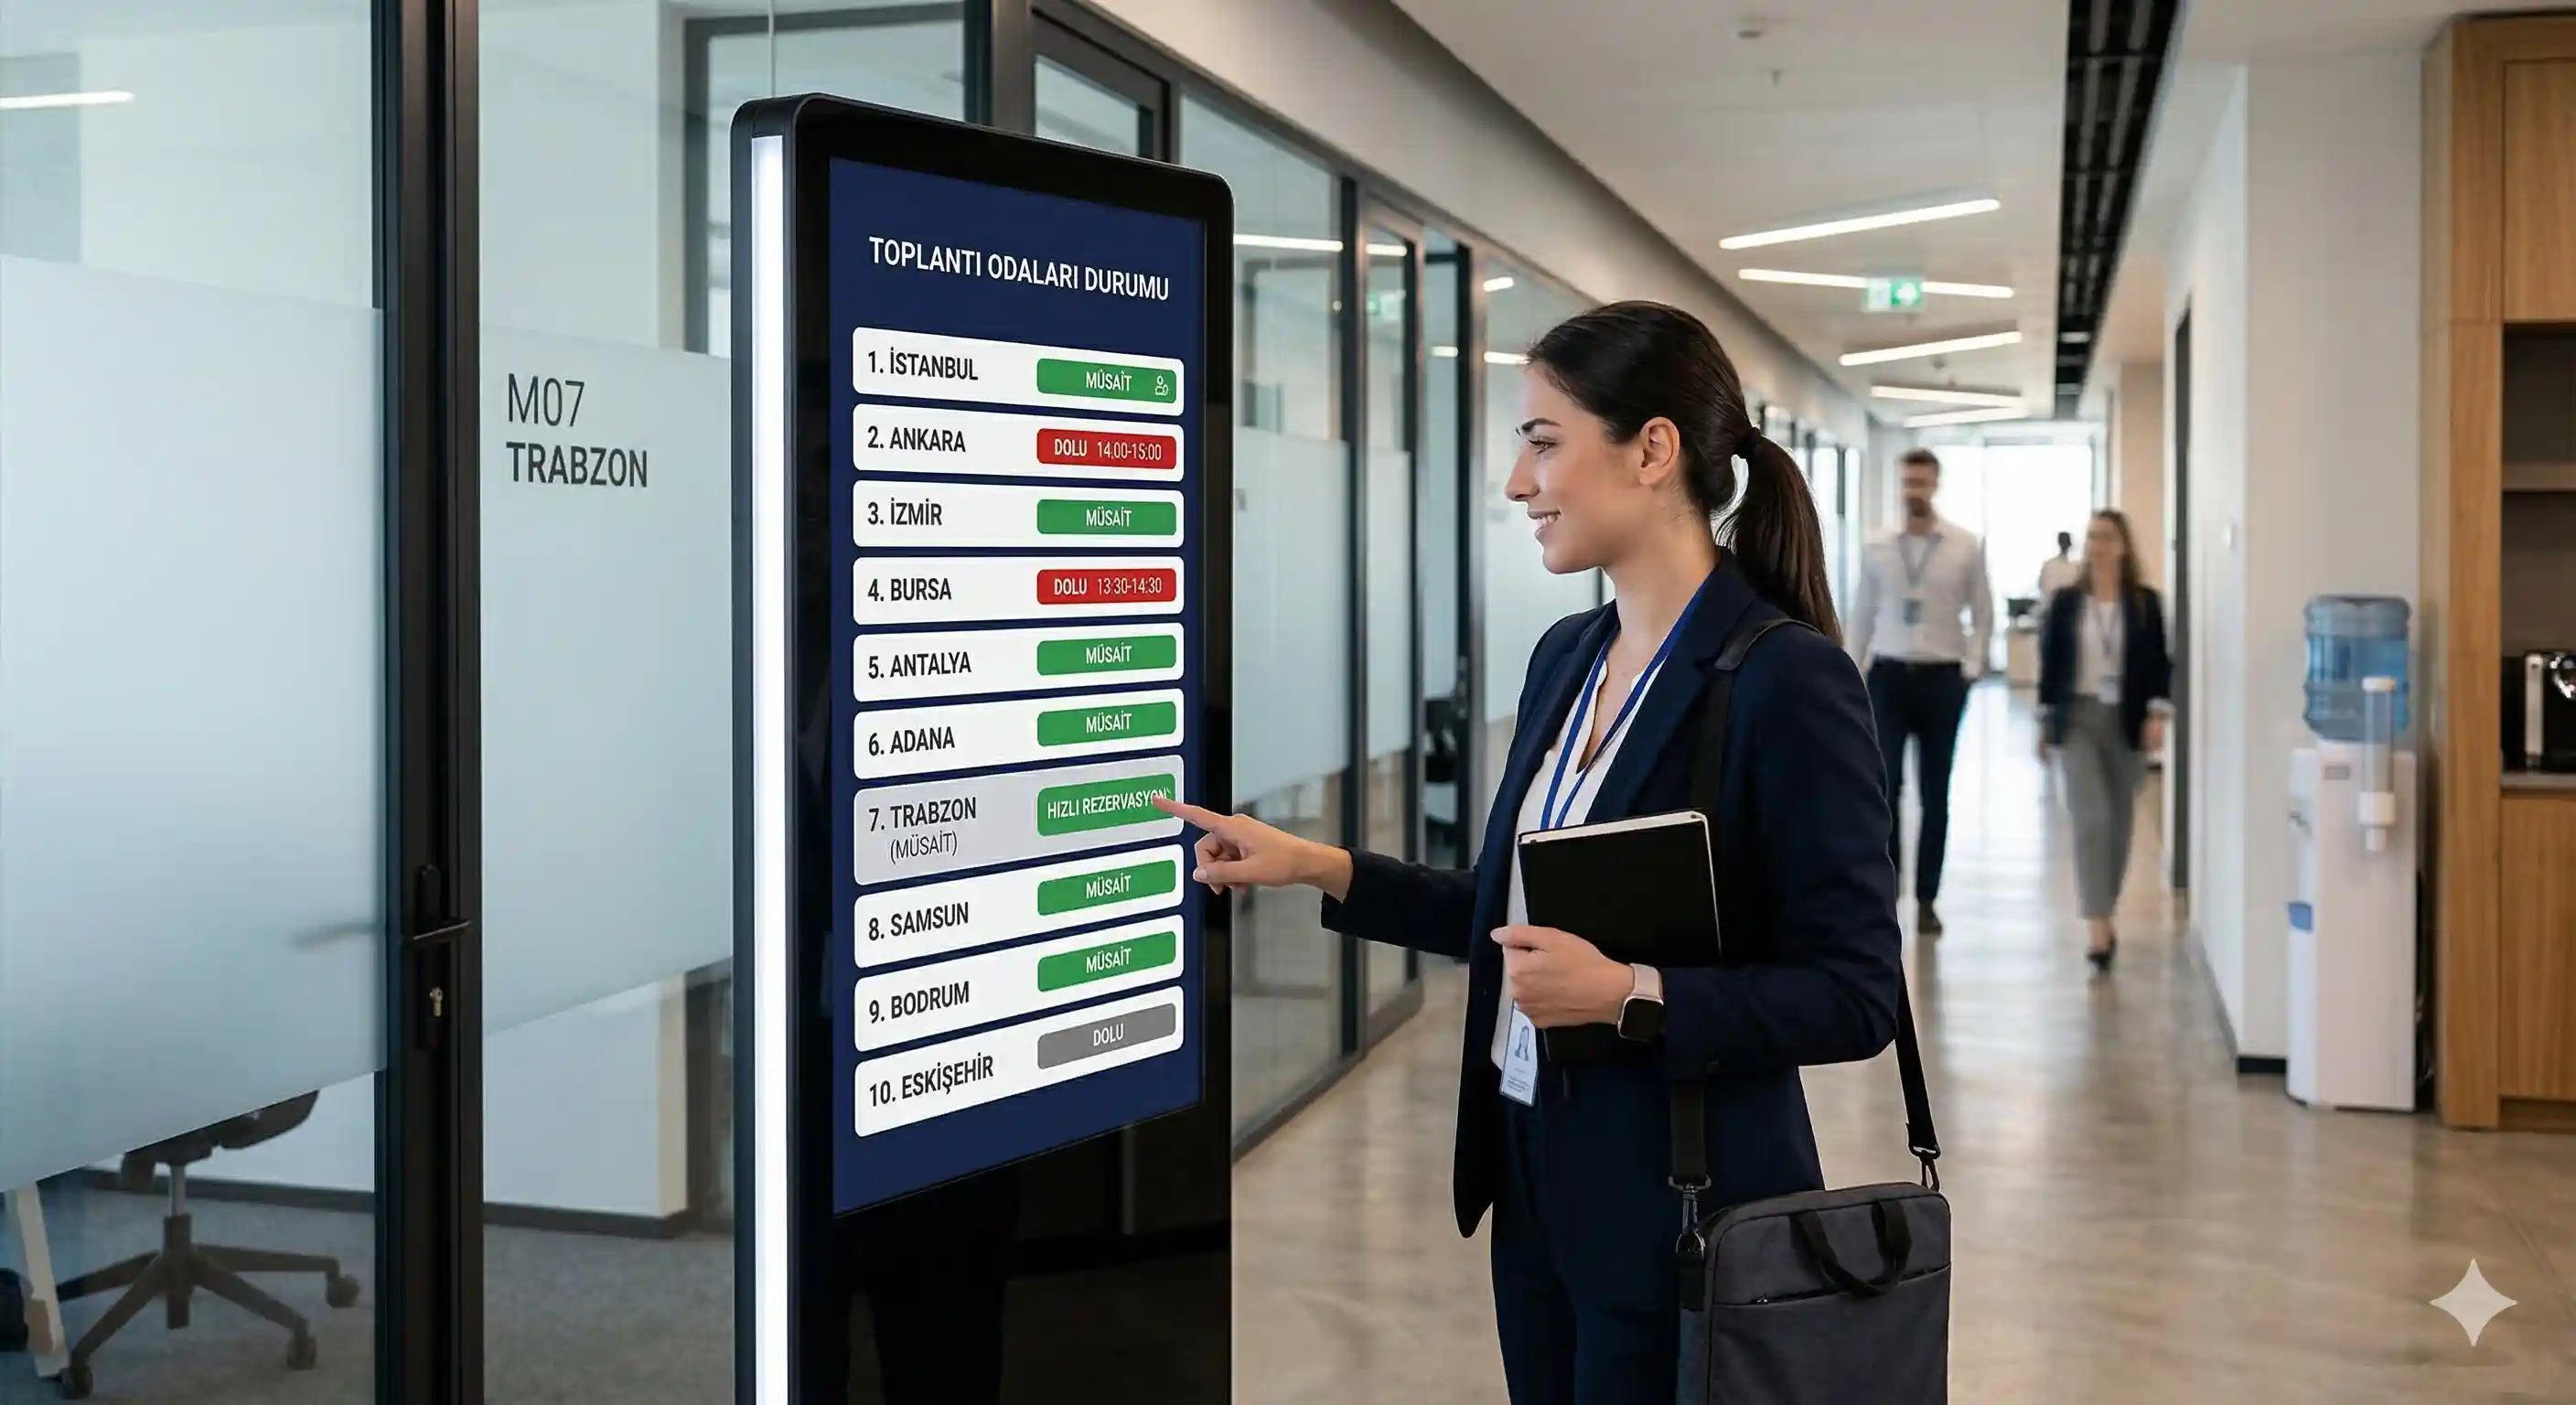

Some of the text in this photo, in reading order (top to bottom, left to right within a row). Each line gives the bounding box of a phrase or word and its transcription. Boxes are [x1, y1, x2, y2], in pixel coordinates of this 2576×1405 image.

[868, 236, 1169, 301] TOPLANTI ODALARI DURUMU
[868, 346, 979, 381] 1. İSTANBUL
[1086, 369, 1132, 392] MÜSAİT
[508, 372, 585, 427] M07
[867, 425, 966, 453] 2. ANKARA
[1054, 438, 1088, 457] DOLU
[506, 441, 648, 488] TRABZON
[867, 497, 942, 526] 3. İZMİR
[1086, 506, 1132, 527] MÜSAİT
[867, 577, 952, 602] 4. BURSA
[1054, 577, 1088, 595] DOLU
[867, 651, 972, 680] 5. ANTALYA
[1086, 642, 1132, 664] MÜSAİT
[1086, 710, 1132, 734] MÜSAİT
[868, 726, 956, 756] 6. ADANA
[868, 797, 977, 832] 7. TRABZON
[1047, 799, 1079, 820] HIZLI
[890, 830, 958, 864] (MÜSAİT)
[1085, 874, 1132, 900] MÜSAİT
[868, 901, 969, 941] 8. SAMSUN
[1085, 947, 1132, 973] MÜSAİT
[868, 981, 970, 1024] 9. BODRUM
[1092, 1023, 1124, 1047] DOLU
[869, 1051, 994, 1107] 10. ESKİŞEHİR
